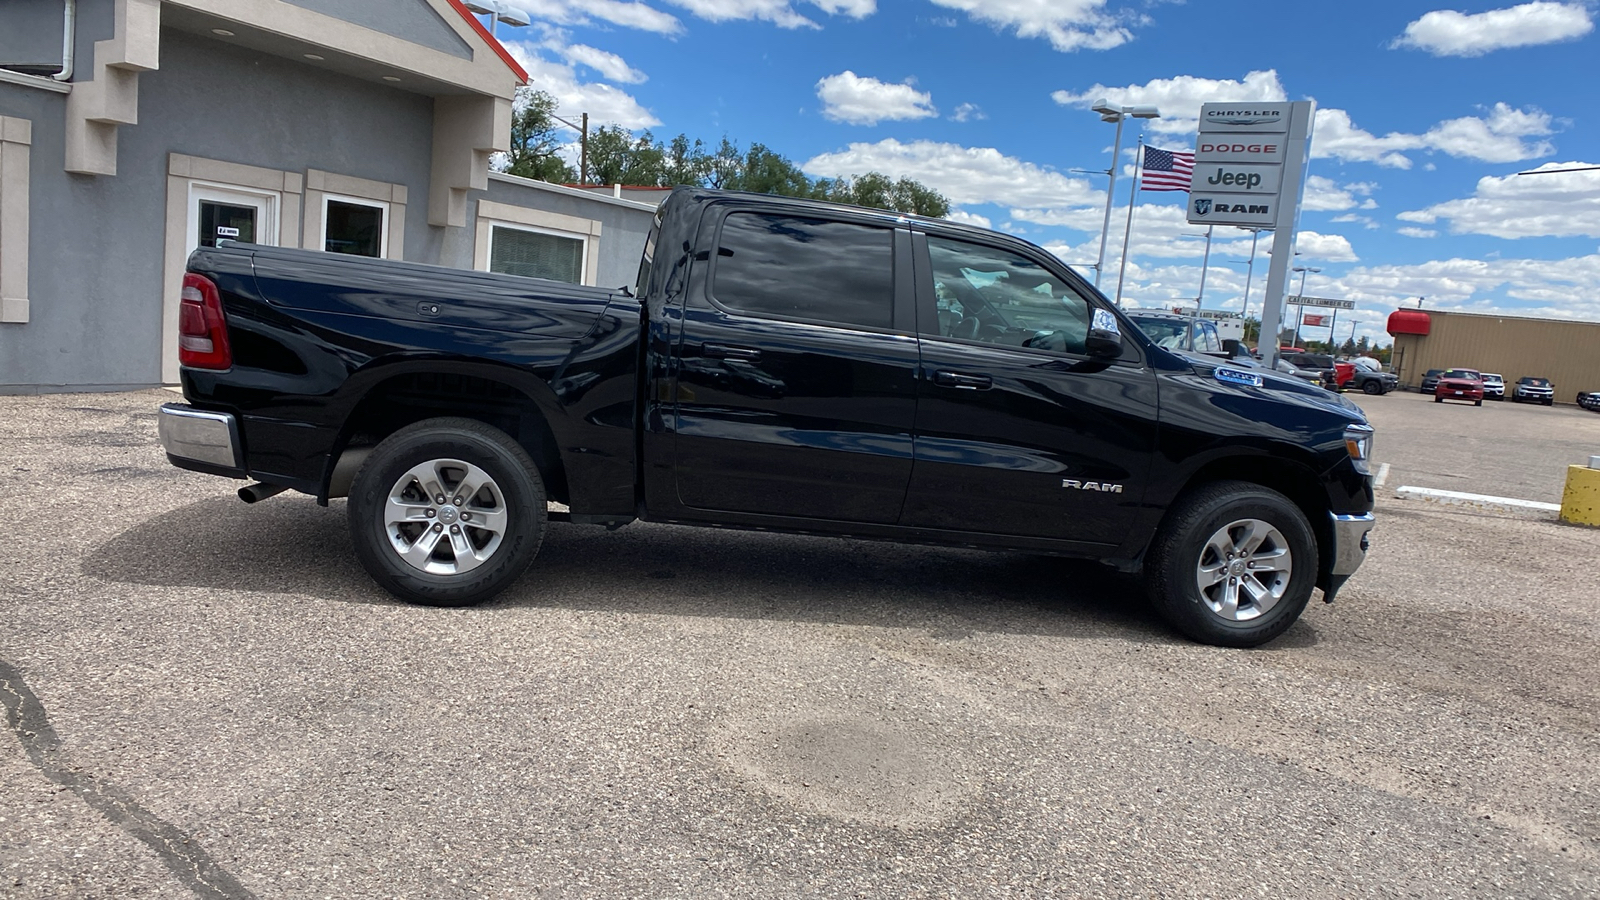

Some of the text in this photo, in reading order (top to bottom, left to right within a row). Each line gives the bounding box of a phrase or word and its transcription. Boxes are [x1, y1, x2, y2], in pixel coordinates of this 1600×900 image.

[1201, 144, 1277, 153] DODGE
[1207, 168, 1261, 189] Jeep
[1214, 203, 1269, 214] RAM
[1062, 479, 1123, 493] RAM
